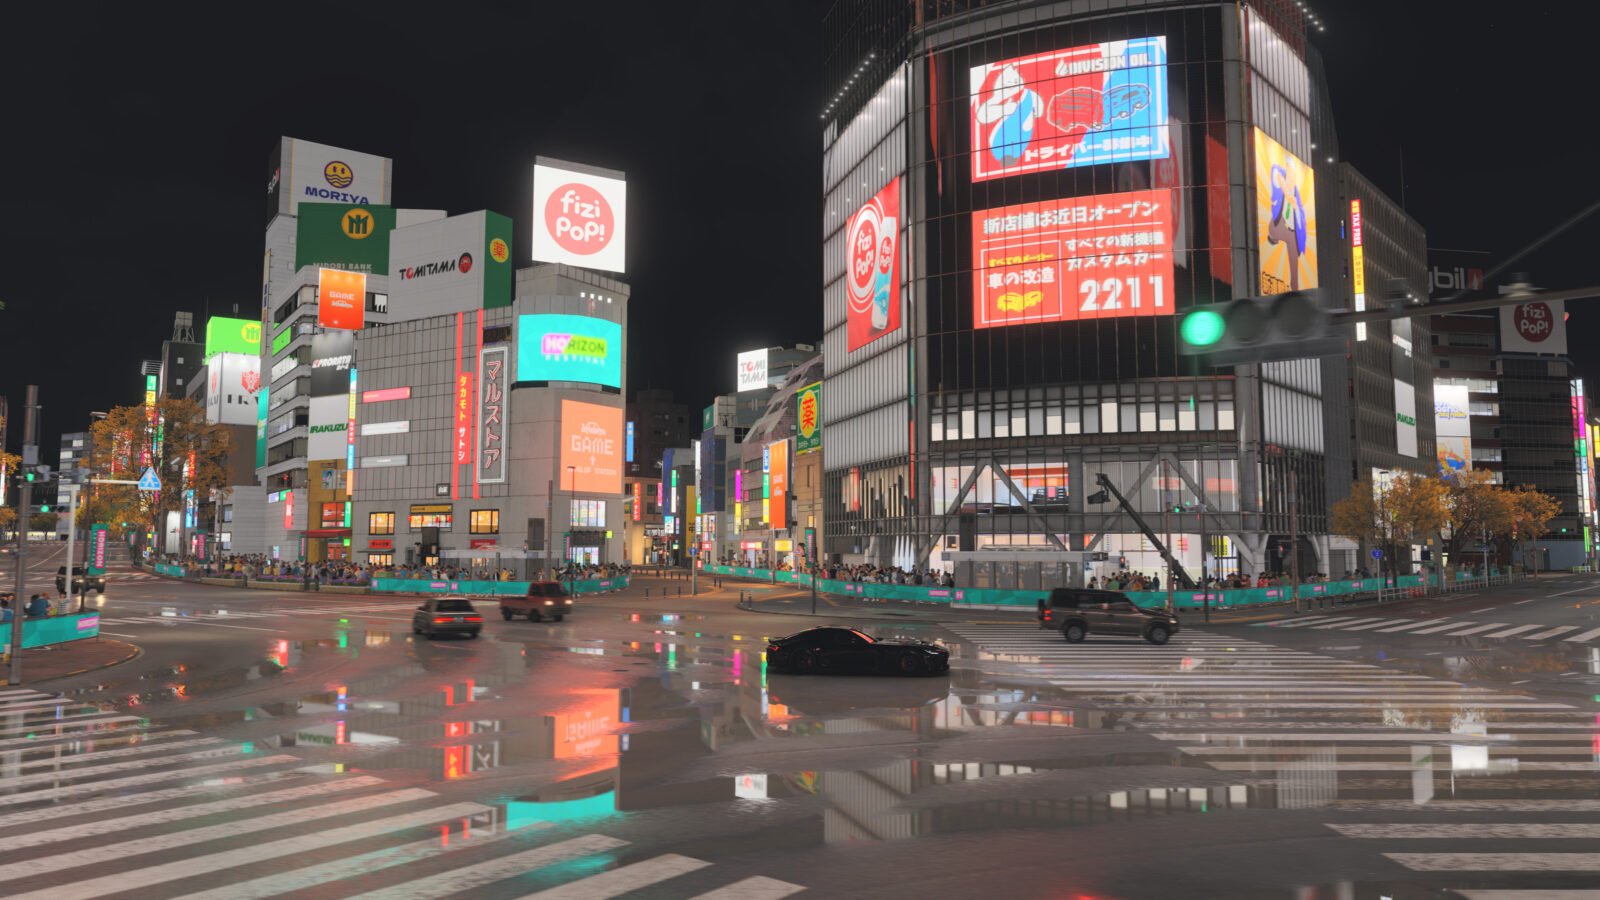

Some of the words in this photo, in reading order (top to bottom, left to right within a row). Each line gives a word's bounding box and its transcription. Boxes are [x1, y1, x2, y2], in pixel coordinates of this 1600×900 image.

[1069, 56, 1126, 75] DIVISION
[1130, 53, 1152, 67] OIL
[305, 186, 370, 205] MORIYA
[560, 189, 601, 218] fizi
[983, 200, 1159, 234] 新店舗は近日オープン
[857, 228, 872, 255] fizi
[312, 262, 346, 270] MIDORI
[348, 263, 373, 271] BANK
[399, 259, 456, 280] TOMITAMA
[1066, 249, 1164, 272] カスタムカー
[987, 267, 1055, 289] 車の改造
[1079, 275, 1165, 312] 2211
[1522, 303, 1545, 318] fizi
[543, 336, 605, 353] HORIZON
[740, 360, 766, 373] TOMI
[740, 370, 766, 384] TAMA
[458, 375, 468, 422] タカモト
[484, 360, 502, 469] マルストア
[457, 427, 466, 461] サトシ
[571, 434, 614, 456] GAME
[96, 530, 106, 568] HORIZON
